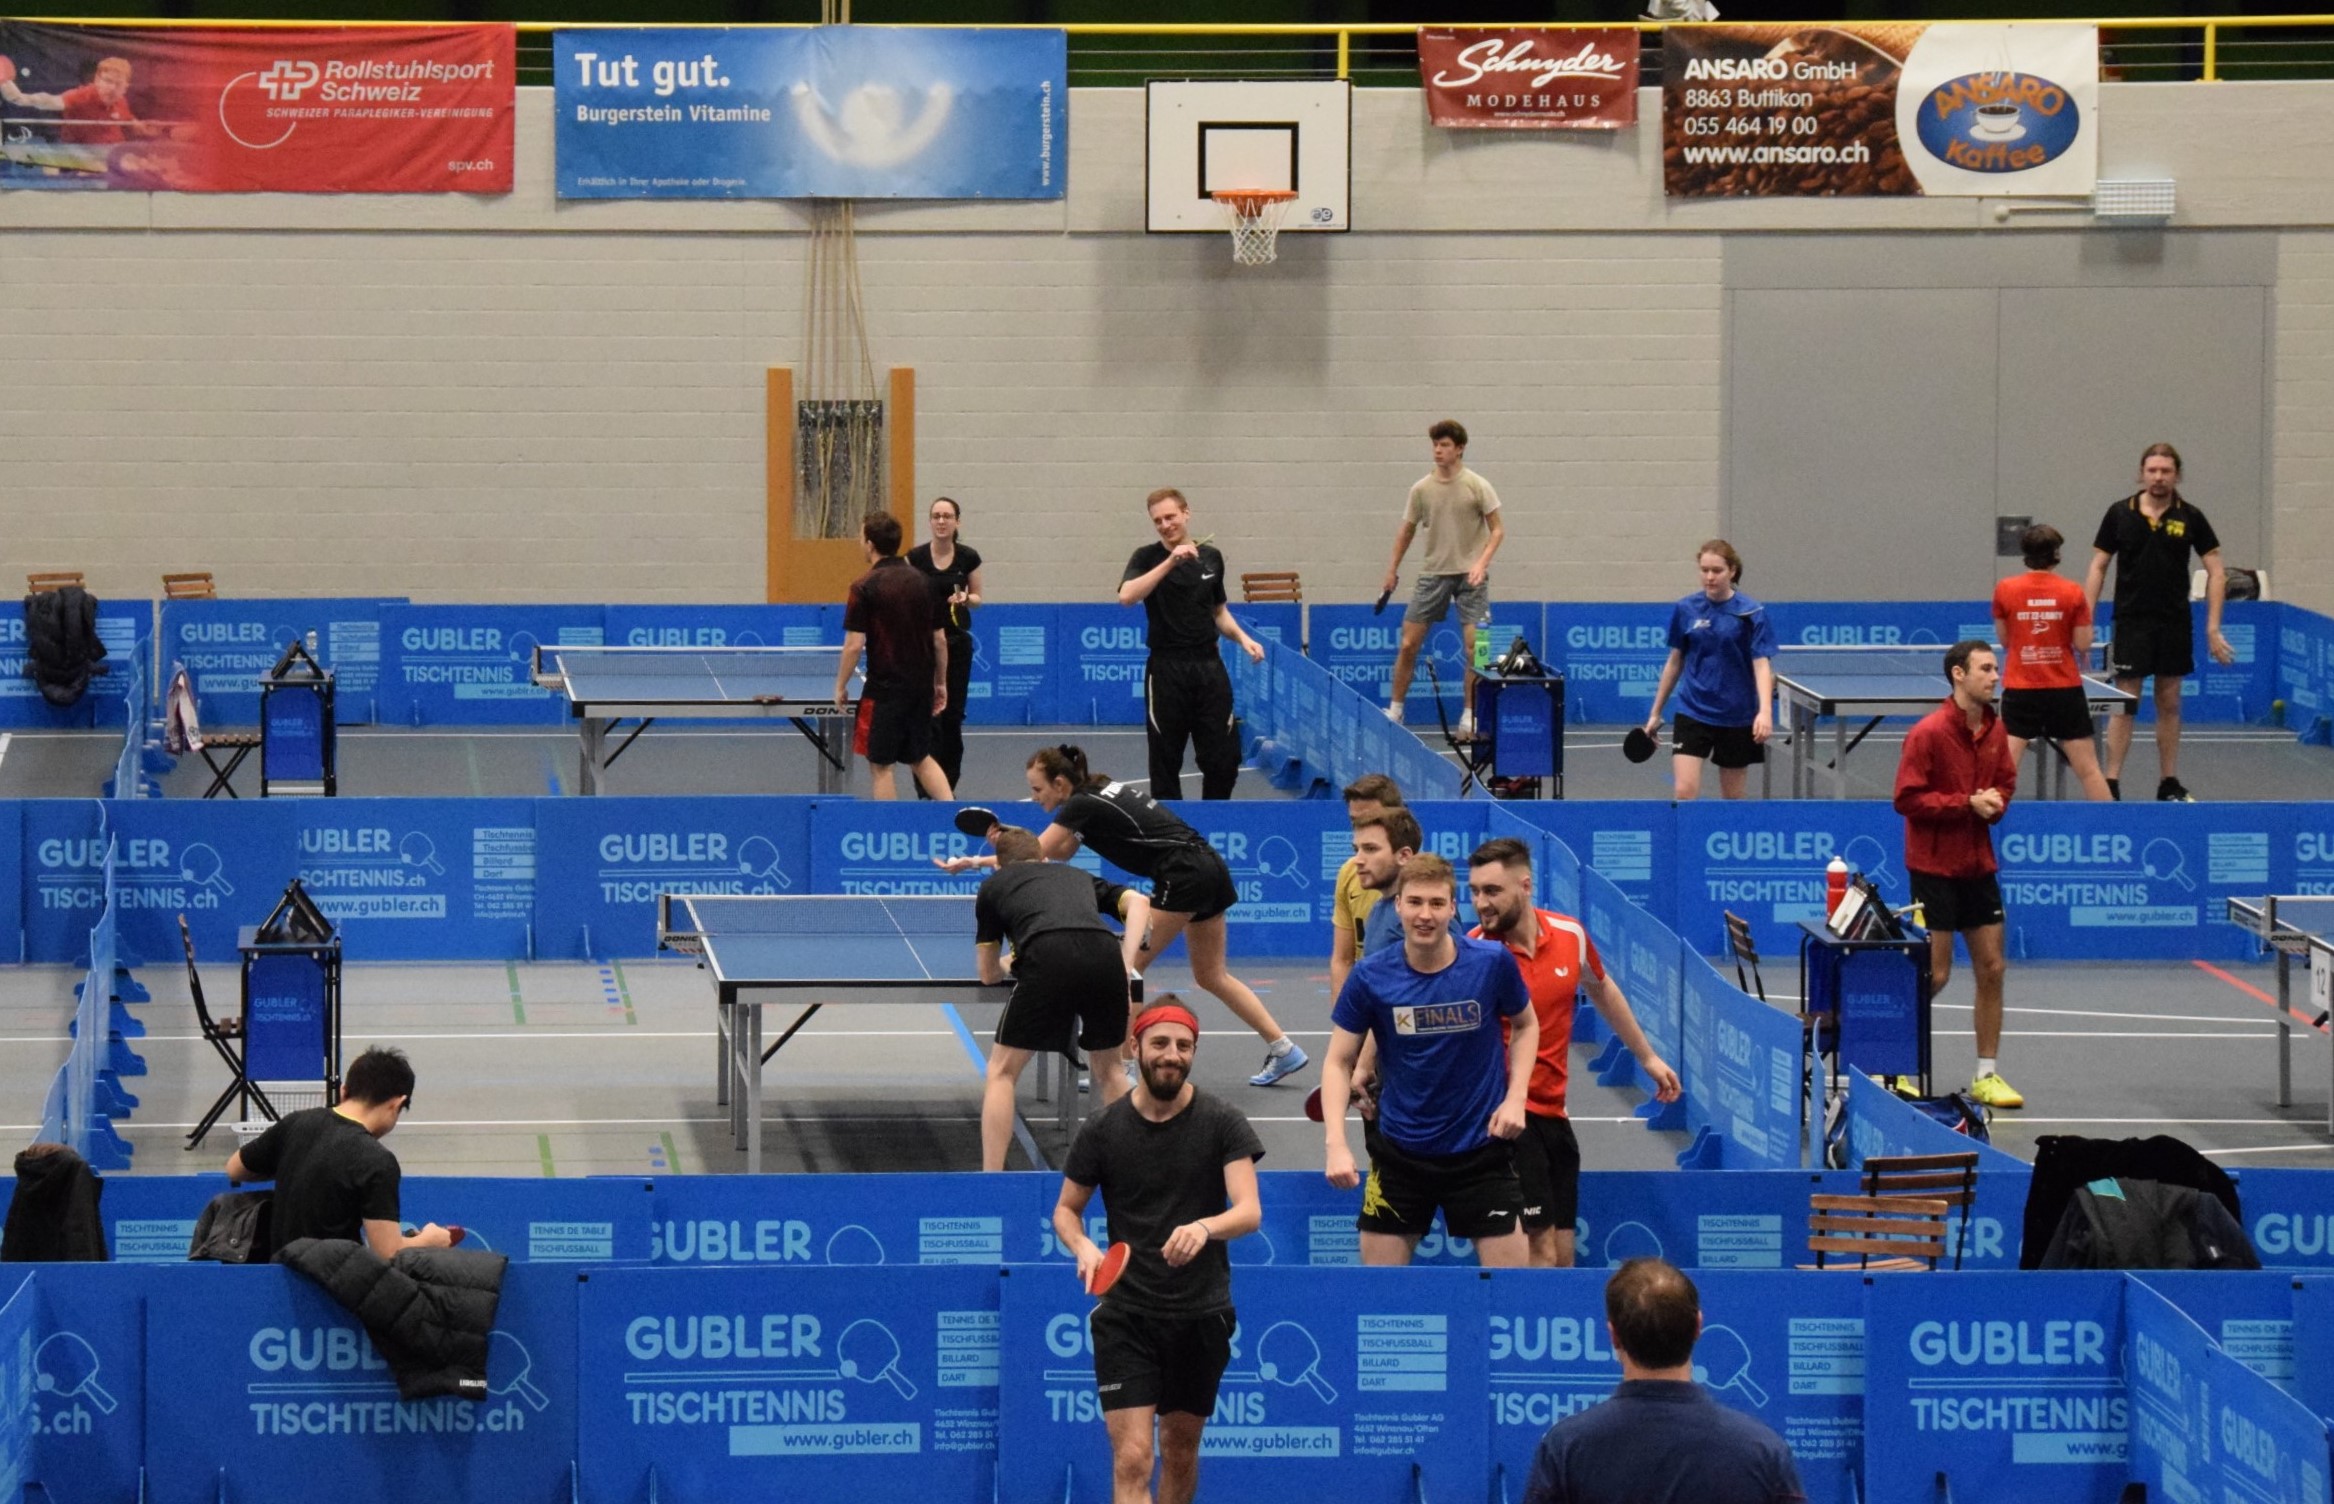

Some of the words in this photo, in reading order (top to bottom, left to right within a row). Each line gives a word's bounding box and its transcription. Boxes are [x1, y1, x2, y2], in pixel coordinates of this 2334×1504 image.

[325, 60, 494, 83] Rollstuhlsport
[1433, 38, 1626, 89] Schnyder
[1684, 58, 1788, 81] ANSARO
[1793, 60, 1857, 81] GmbH
[574, 53, 640, 87] Tut
[653, 54, 730, 96] gut.
[320, 81, 421, 102] Schweiz
[1466, 94, 1601, 108] MODEHAUS
[1685, 89, 1732, 108] 8863
[1738, 89, 1813, 108] Buttikon
[1934, 71, 2066, 121] ANSARO
[266, 107, 330, 118] SCHWEIZER
[333, 107, 494, 118] PARAPLEGIKER-VEREINIGUNG
[577, 105, 682, 125] Burgerstein
[689, 105, 771, 122] Vitamine
[1684, 117, 1723, 135] 055
[1724, 117, 1761, 135] 464
[1767, 117, 1787, 135] 19
[1791, 117, 1817, 135] 00
[1684, 140, 1870, 164] www.ansaro.ch
[1946, 139, 2047, 169] Kaffee
[448, 159, 494, 173] spv.ch
[180, 622, 266, 643] GUBLER
[402, 627, 502, 652] GUBLER
[628, 627, 726, 647] GUBLER
[1081, 626, 1147, 649] GUBL
[1330, 627, 1402, 650] GUBL
[1567, 625, 1667, 649] GUBLER
[1802, 625, 1901, 646] GUBLER
[402, 665, 513, 683] TISCHTENNIS
[1081, 663, 1147, 682] TISCHT
[1567, 664, 1661, 681] TISCHTENN
[803, 707, 857, 715] DONC
[299, 828, 391, 853] UBLER
[599, 833, 728, 862] GUBLER
[841, 832, 968, 861] GUBLER
[1706, 831, 1835, 861] GUBLER
[2001, 833, 2132, 863] GUBLER
[300, 869, 426, 888] SCHTENNIS.ch
[600, 881, 775, 903] TISCHTENNISch
[1707, 880, 1827, 902] TISCHTENN
[2001, 883, 2148, 906] TISCHTENNIS
[2106, 910, 2193, 923] www.gubler.ch
[254, 997, 298, 1008] GUBLER
[1416, 1004, 1479, 1027] FINALS
[1524, 1206, 1542, 1215] NIC
[120, 1224, 179, 1233] TISCHTENNIS
[534, 1227, 565, 1235] TENNIS
[567, 1227, 579, 1235] DE
[582, 1226, 607, 1235] TABLE
[924, 1221, 981, 1230] TISCHTENNIS
[1313, 1220, 1357, 1228] TISCHTEN
[1703, 1218, 1760, 1228] TISCHTENNIS
[924, 1240, 990, 1248] TISCHFUSSBALL
[1313, 1238, 1359, 1246] TISCHFUSS
[1313, 1255, 1348, 1264] BILLARD
[1703, 1255, 1738, 1263] BILLARD
[942, 1315, 976, 1324] TENNIS
[978, 1315, 991, 1324] DE
[1362, 1319, 1424, 1328] TISCHTENNIS
[1793, 1322, 1855, 1332] TISCHTENNIS
[2227, 1324, 2261, 1333] TENNIS
[2264, 1324, 2277, 1333] DE
[625, 1314, 822, 1360] GUBLER
[1362, 1338, 1433, 1348] TISCHFUSSBALL
[1489, 1316, 1617, 1361] GUBL
[1909, 1320, 2105, 1366] GUBLER
[250, 1327, 388, 1371] GUBL
[942, 1354, 979, 1363] BILLARD
[1362, 1358, 1399, 1367] BILLARD
[1793, 1362, 1831, 1371] BILLARD
[2136, 1331, 2182, 1404] GUBLER
[942, 1374, 966, 1382] DART
[1362, 1378, 1386, 1386] DART
[1793, 1381, 1817, 1390] DART
[625, 1389, 846, 1424] TISCHTENNIS
[1910, 1397, 2128, 1431] TISCHTENNIS
[250, 1400, 524, 1435] TISCHTENNIS.ch
[783, 1429, 913, 1450] www.gubler.ch
[1203, 1434, 1333, 1453] www.gubler.ch
[2221, 1405, 2277, 1483] GUBLER
